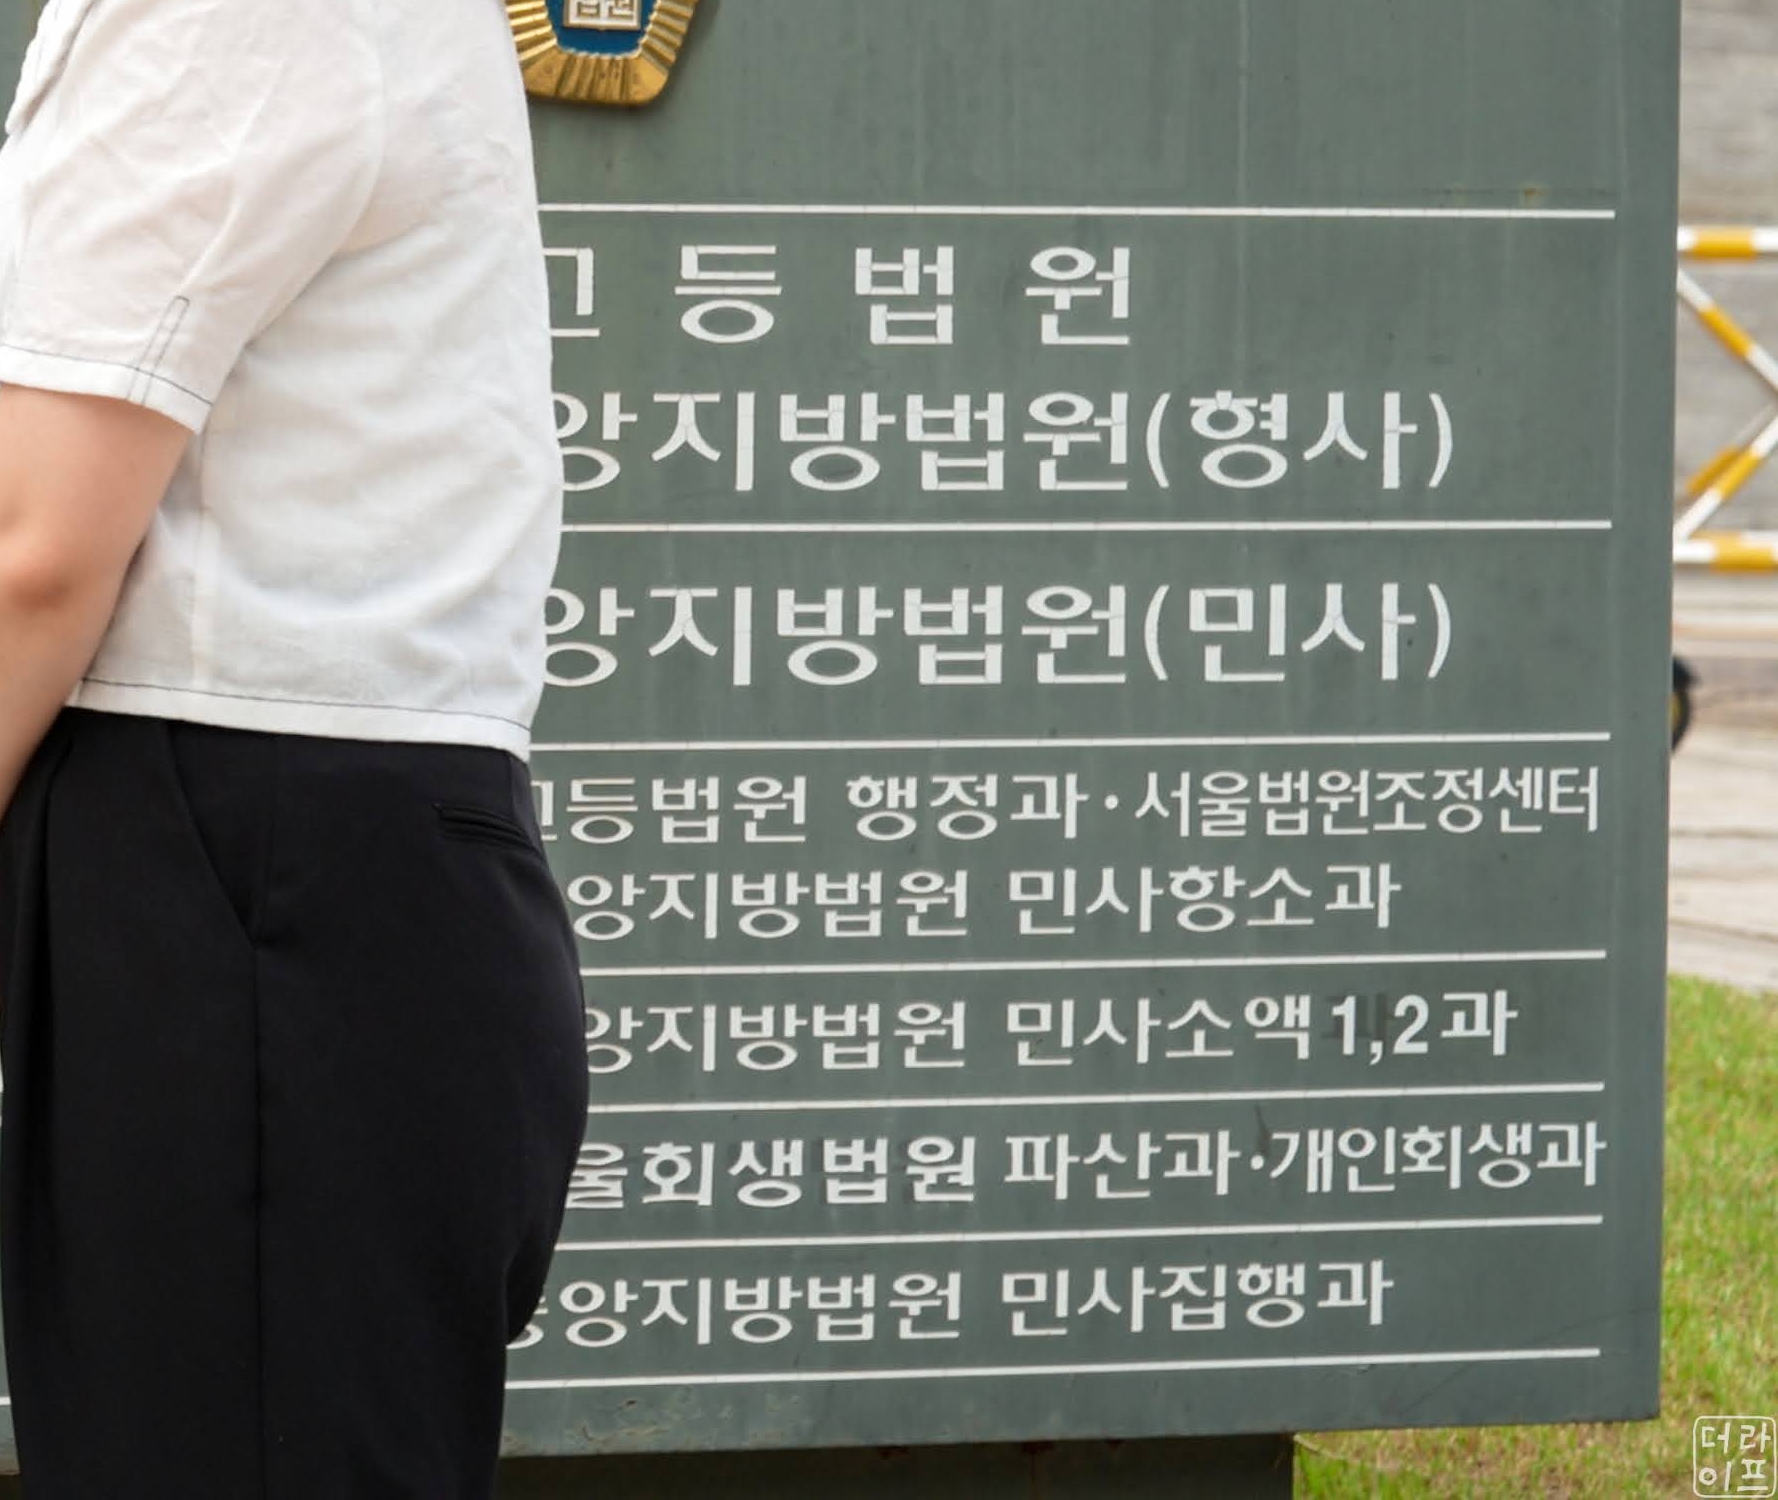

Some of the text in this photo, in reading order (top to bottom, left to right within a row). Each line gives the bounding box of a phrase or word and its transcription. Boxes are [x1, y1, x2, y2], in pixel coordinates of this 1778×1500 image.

[566, 863, 1402, 941] 앙지방법원 민사항소과
[1002, 1259, 1394, 1336] 민사집행과
